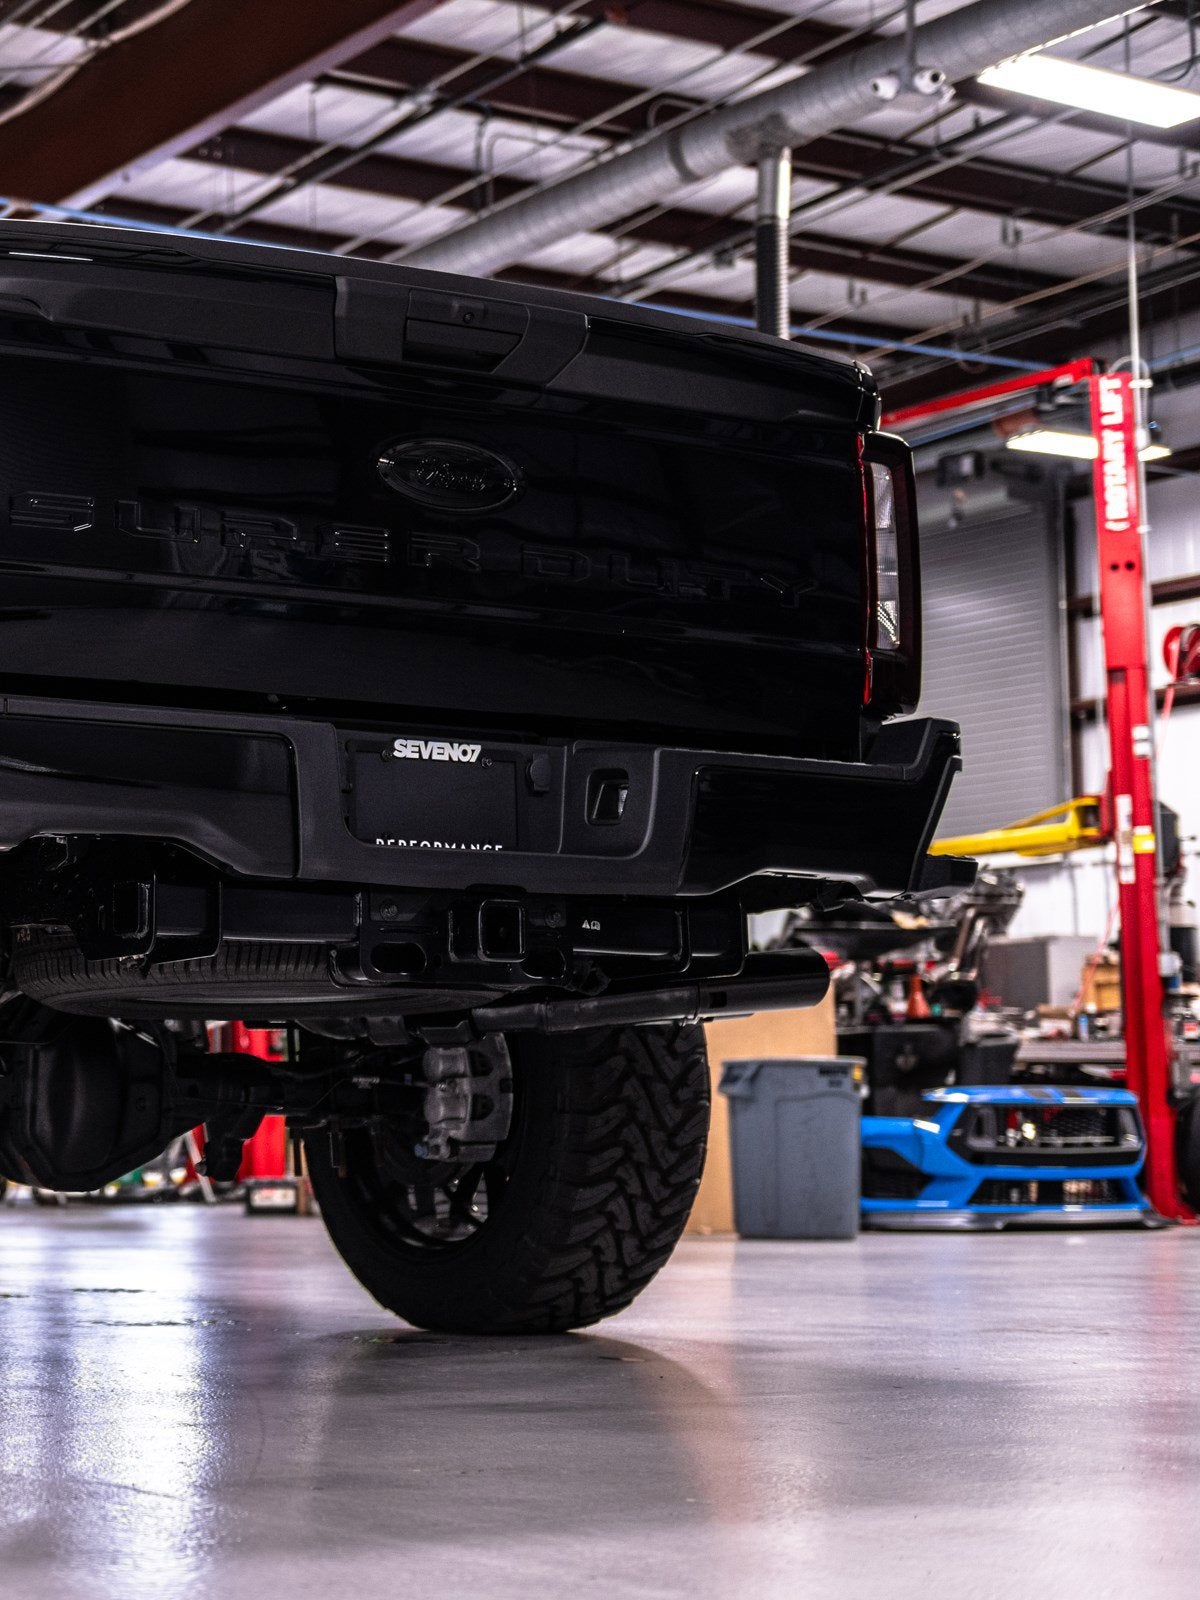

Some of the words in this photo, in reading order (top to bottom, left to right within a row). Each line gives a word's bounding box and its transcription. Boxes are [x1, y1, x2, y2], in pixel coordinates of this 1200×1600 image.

[1099, 376, 1124, 425] LIFT
[413, 456, 490, 493] Ford
[8, 490, 483, 574] SUPER
[520, 543, 819, 609] DUTY
[392, 738, 482, 763] SEVEN07
